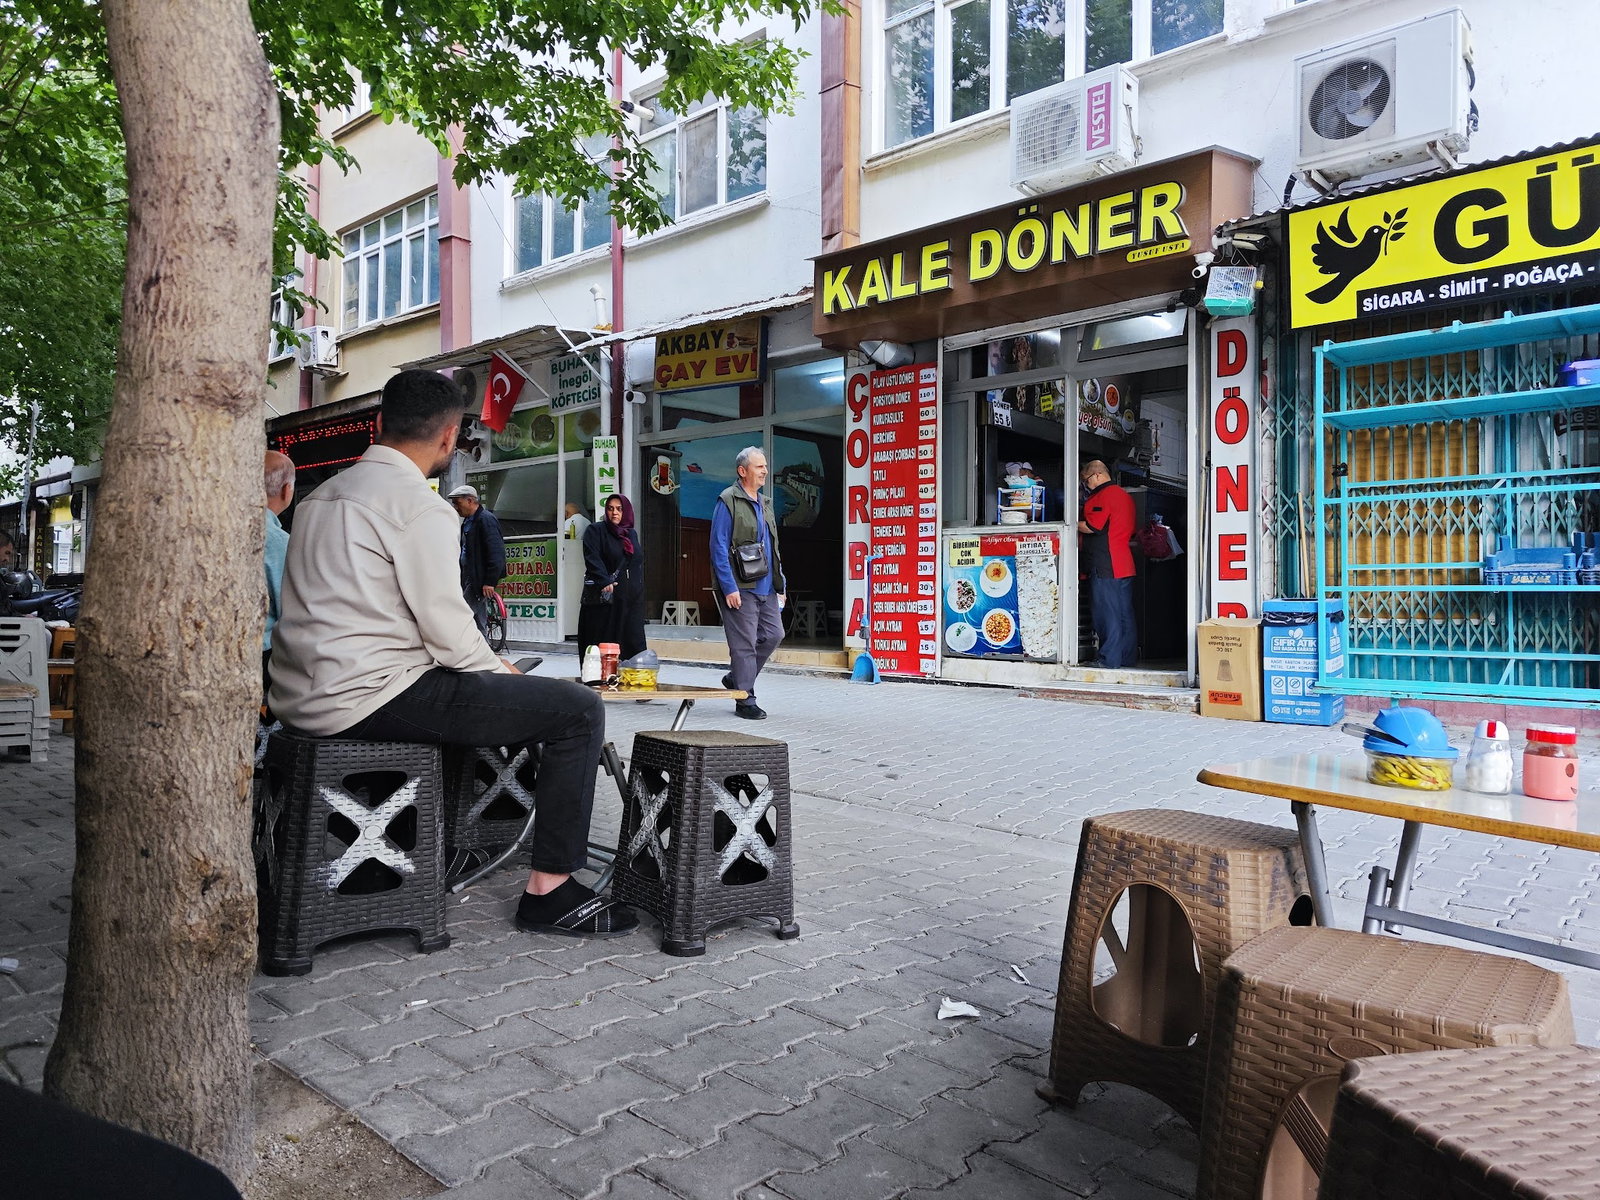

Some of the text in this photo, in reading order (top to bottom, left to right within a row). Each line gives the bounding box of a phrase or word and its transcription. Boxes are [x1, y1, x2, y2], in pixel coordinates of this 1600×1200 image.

[1091, 83, 1106, 149] VESTEL
[1433, 153, 1600, 265] GÜ
[822, 181, 1186, 315] KALE DÖNER
[1132, 242, 1185, 260] YUSUF USTA
[1362, 288, 1425, 313] SİGARA
[1439, 276, 1488, 300] SİMİT
[1503, 262, 1584, 289] POĞAÇA
[658, 328, 725, 357] AKBAY
[551, 353, 600, 375] BUHARA
[656, 347, 757, 388] ÇAY EVİ
[551, 383, 600, 409] KÖFTECİSİ
[920, 409, 930, 417] 60
[995, 412, 1004, 425] 55
[1079, 411, 1092, 427] yet
[846, 373, 871, 637] ÇORBA
[506, 545, 545, 558] 352 57 30
[506, 561, 555, 575] UHARA
